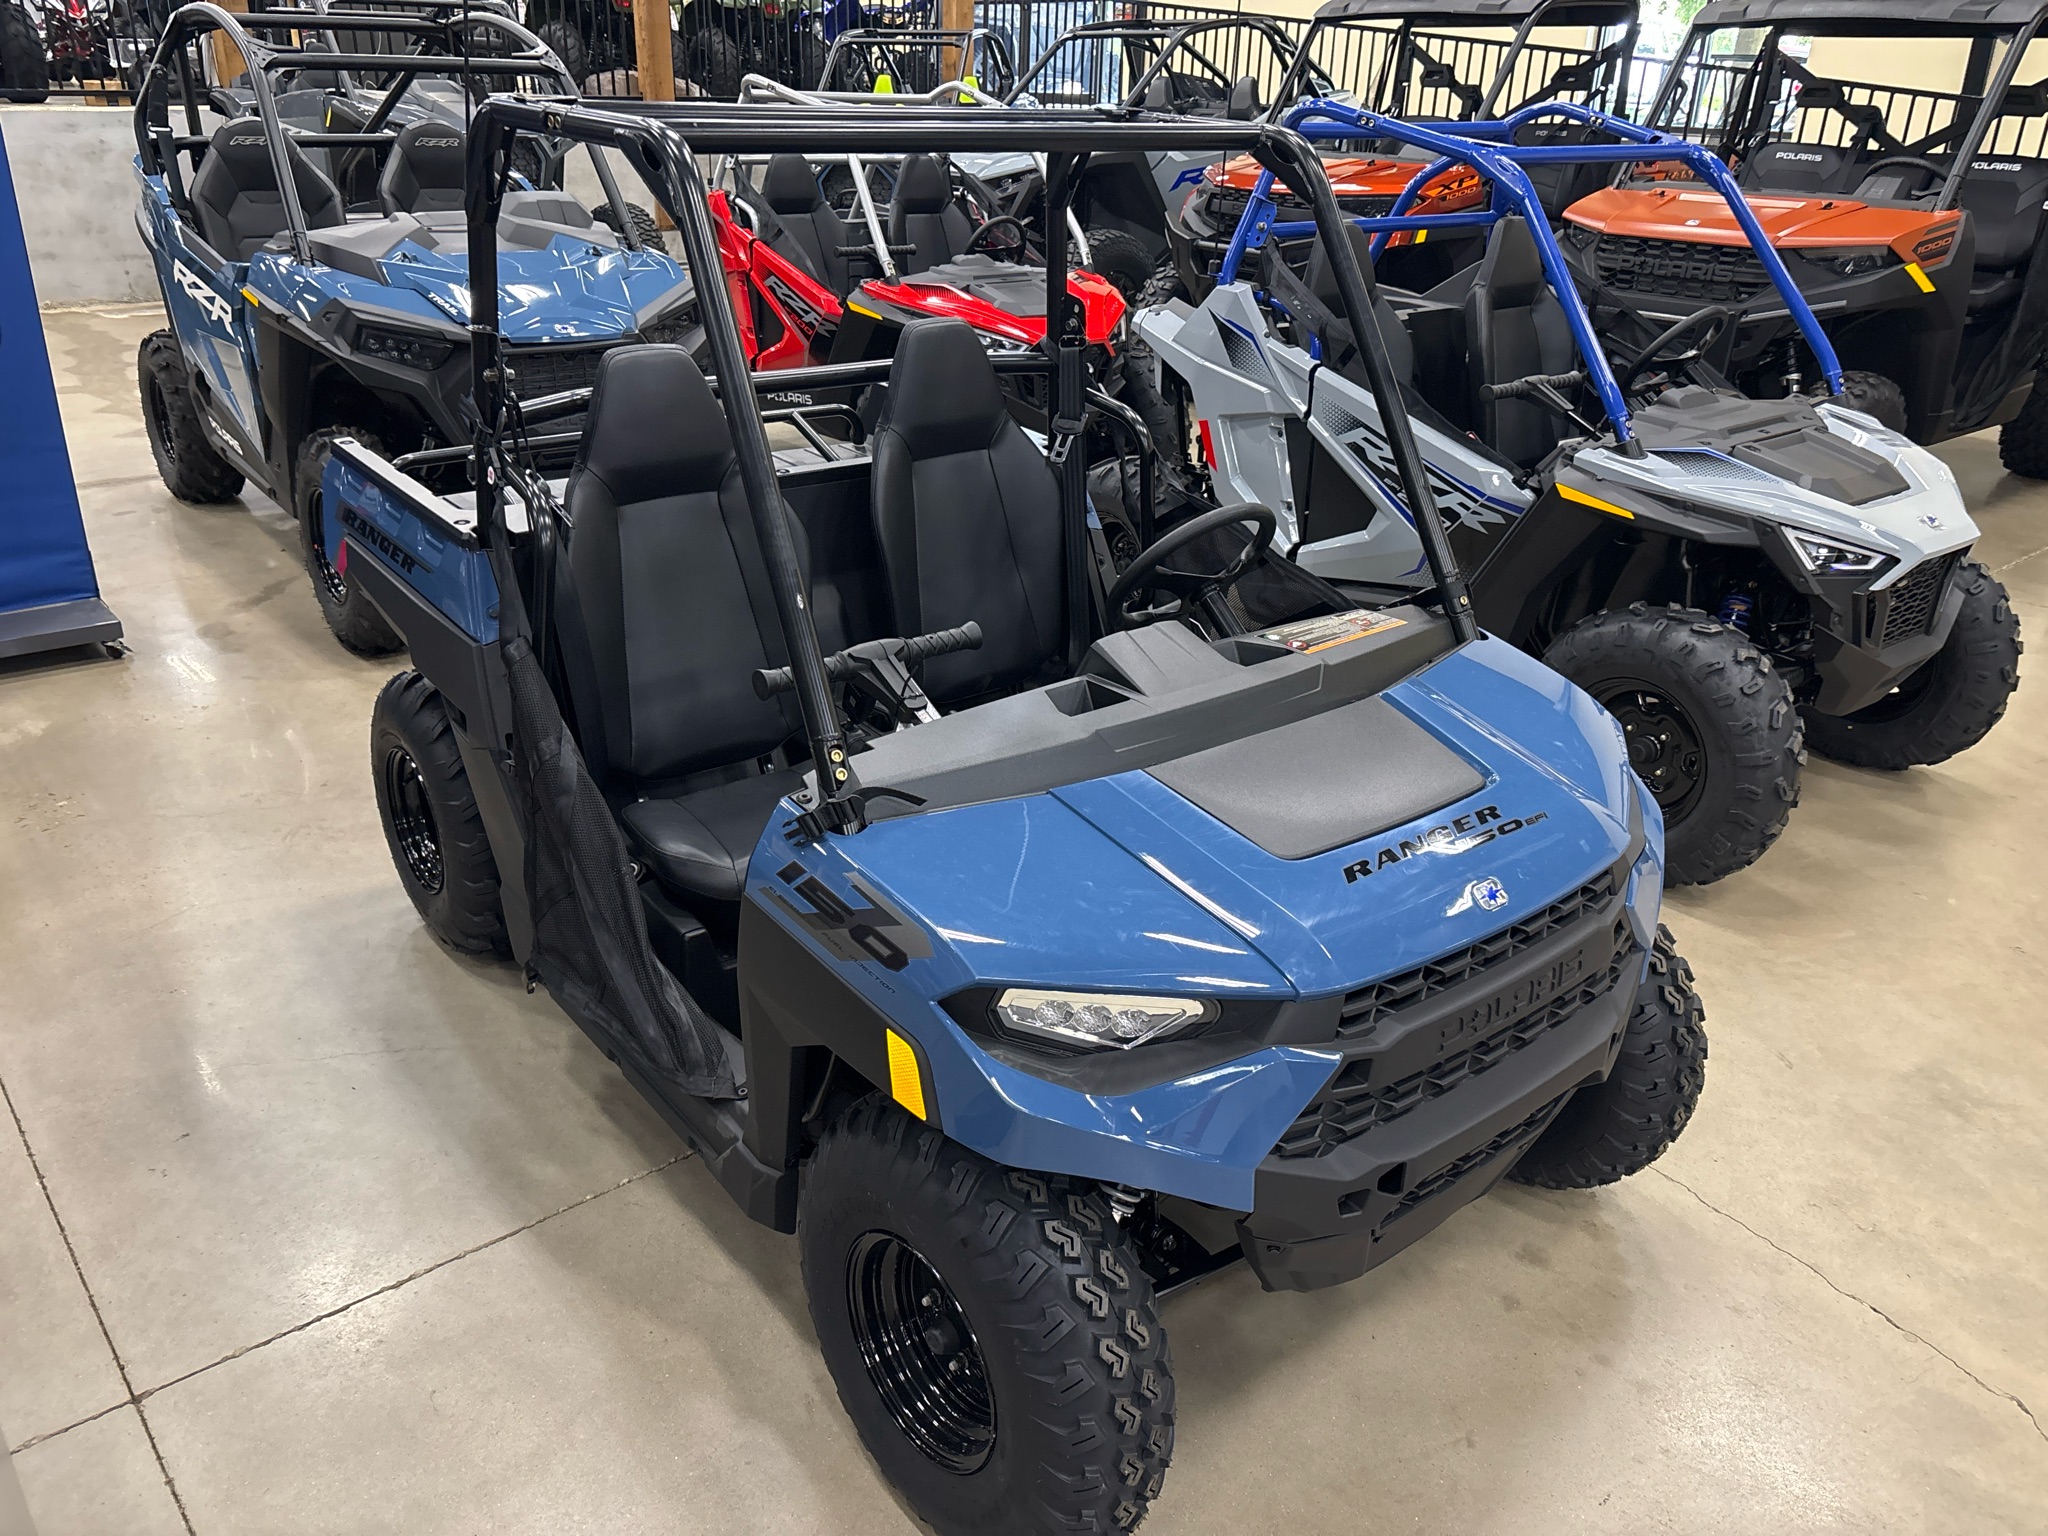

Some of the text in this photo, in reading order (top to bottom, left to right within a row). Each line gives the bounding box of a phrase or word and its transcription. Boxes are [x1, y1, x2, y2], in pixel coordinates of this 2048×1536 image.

[415, 136, 460, 147] RZR
[1775, 151, 1823, 162] POLARIS
[1436, 174, 1477, 195] XP
[1446, 186, 1477, 201] 1000
[1916, 236, 1952, 255] 1000
[1616, 253, 1734, 283] POLARIS
[173, 257, 236, 337] RZR
[428, 291, 459, 316] TRAIL
[763, 274, 839, 339] RZR
[767, 391, 813, 405] POLARIS
[341, 507, 417, 575] RANGER
[1524, 811, 1549, 827] EFI
[1342, 805, 1503, 886] RANGER
[1437, 948, 1584, 1056] POLARIS
